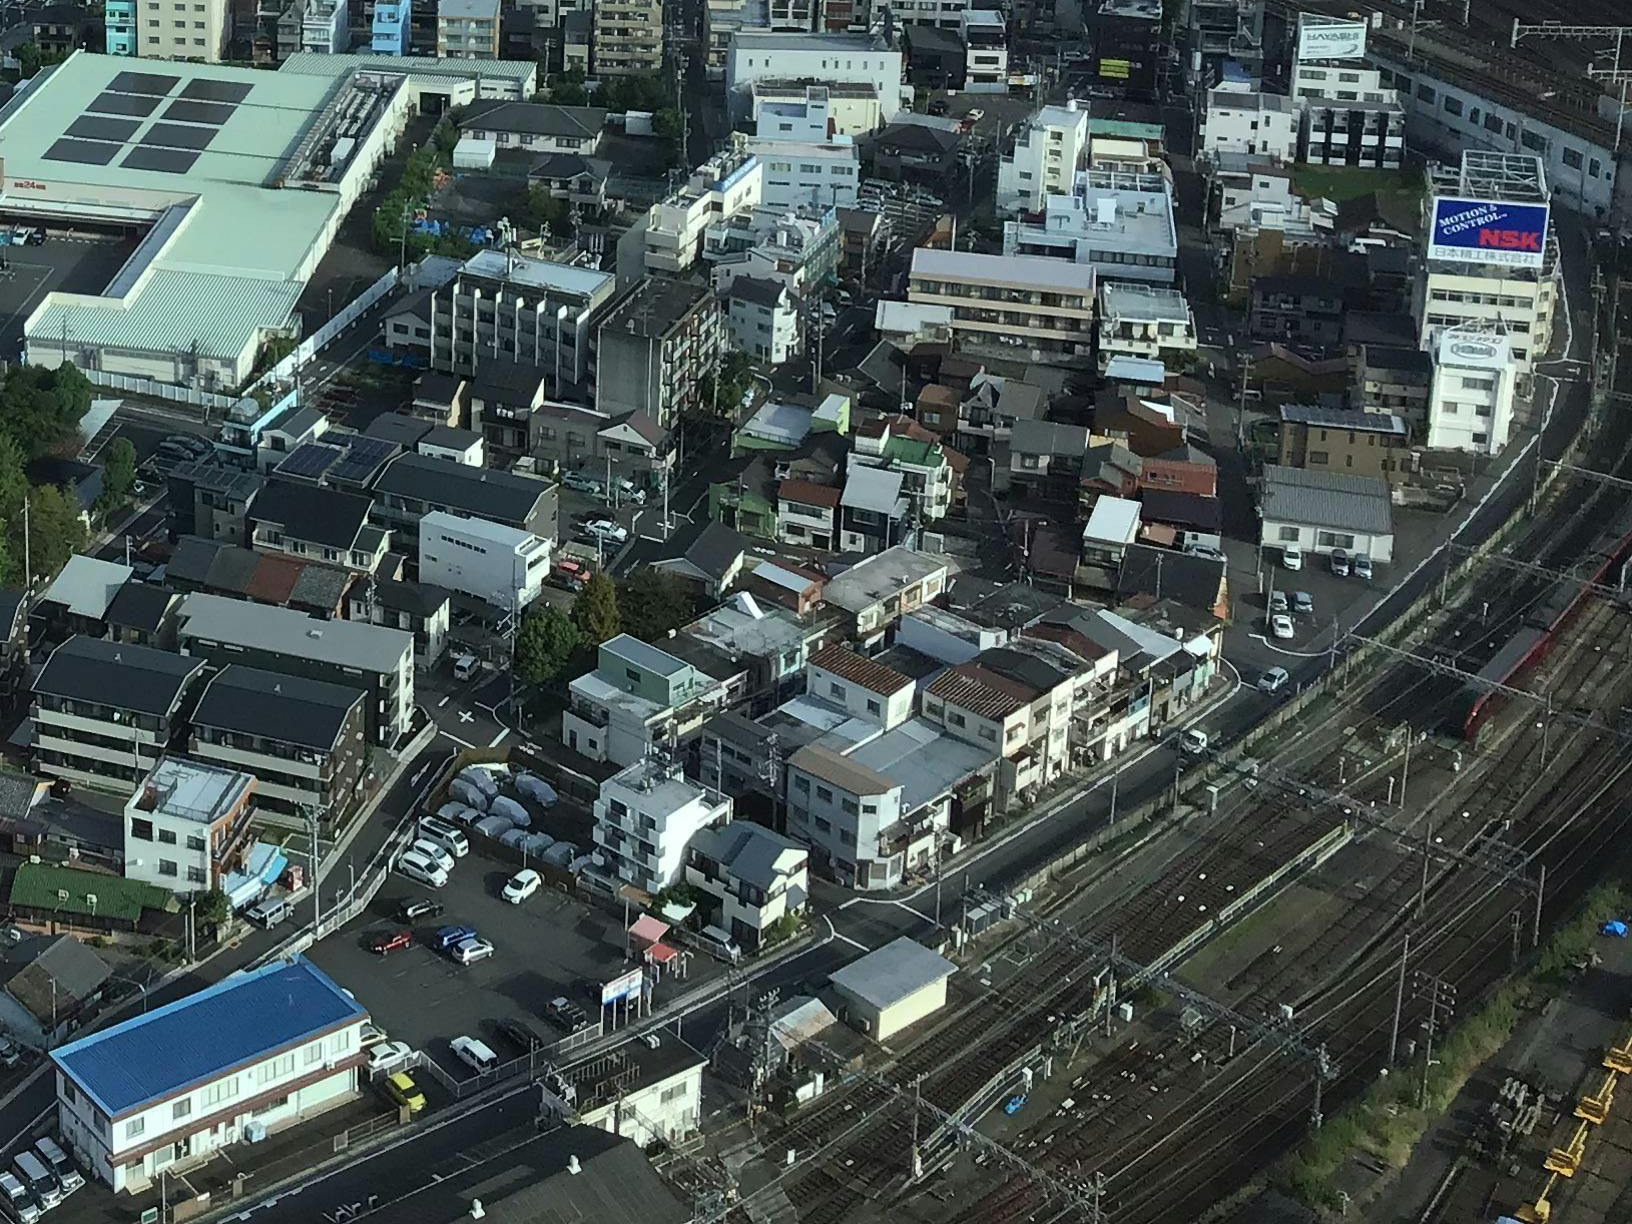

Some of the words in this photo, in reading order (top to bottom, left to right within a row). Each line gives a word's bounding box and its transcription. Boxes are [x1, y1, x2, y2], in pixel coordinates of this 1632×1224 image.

[1439, 205, 1487, 227] MOTION
[1479, 228, 1540, 249] NSK
[1434, 247, 1536, 264] 日本精工株式会社
